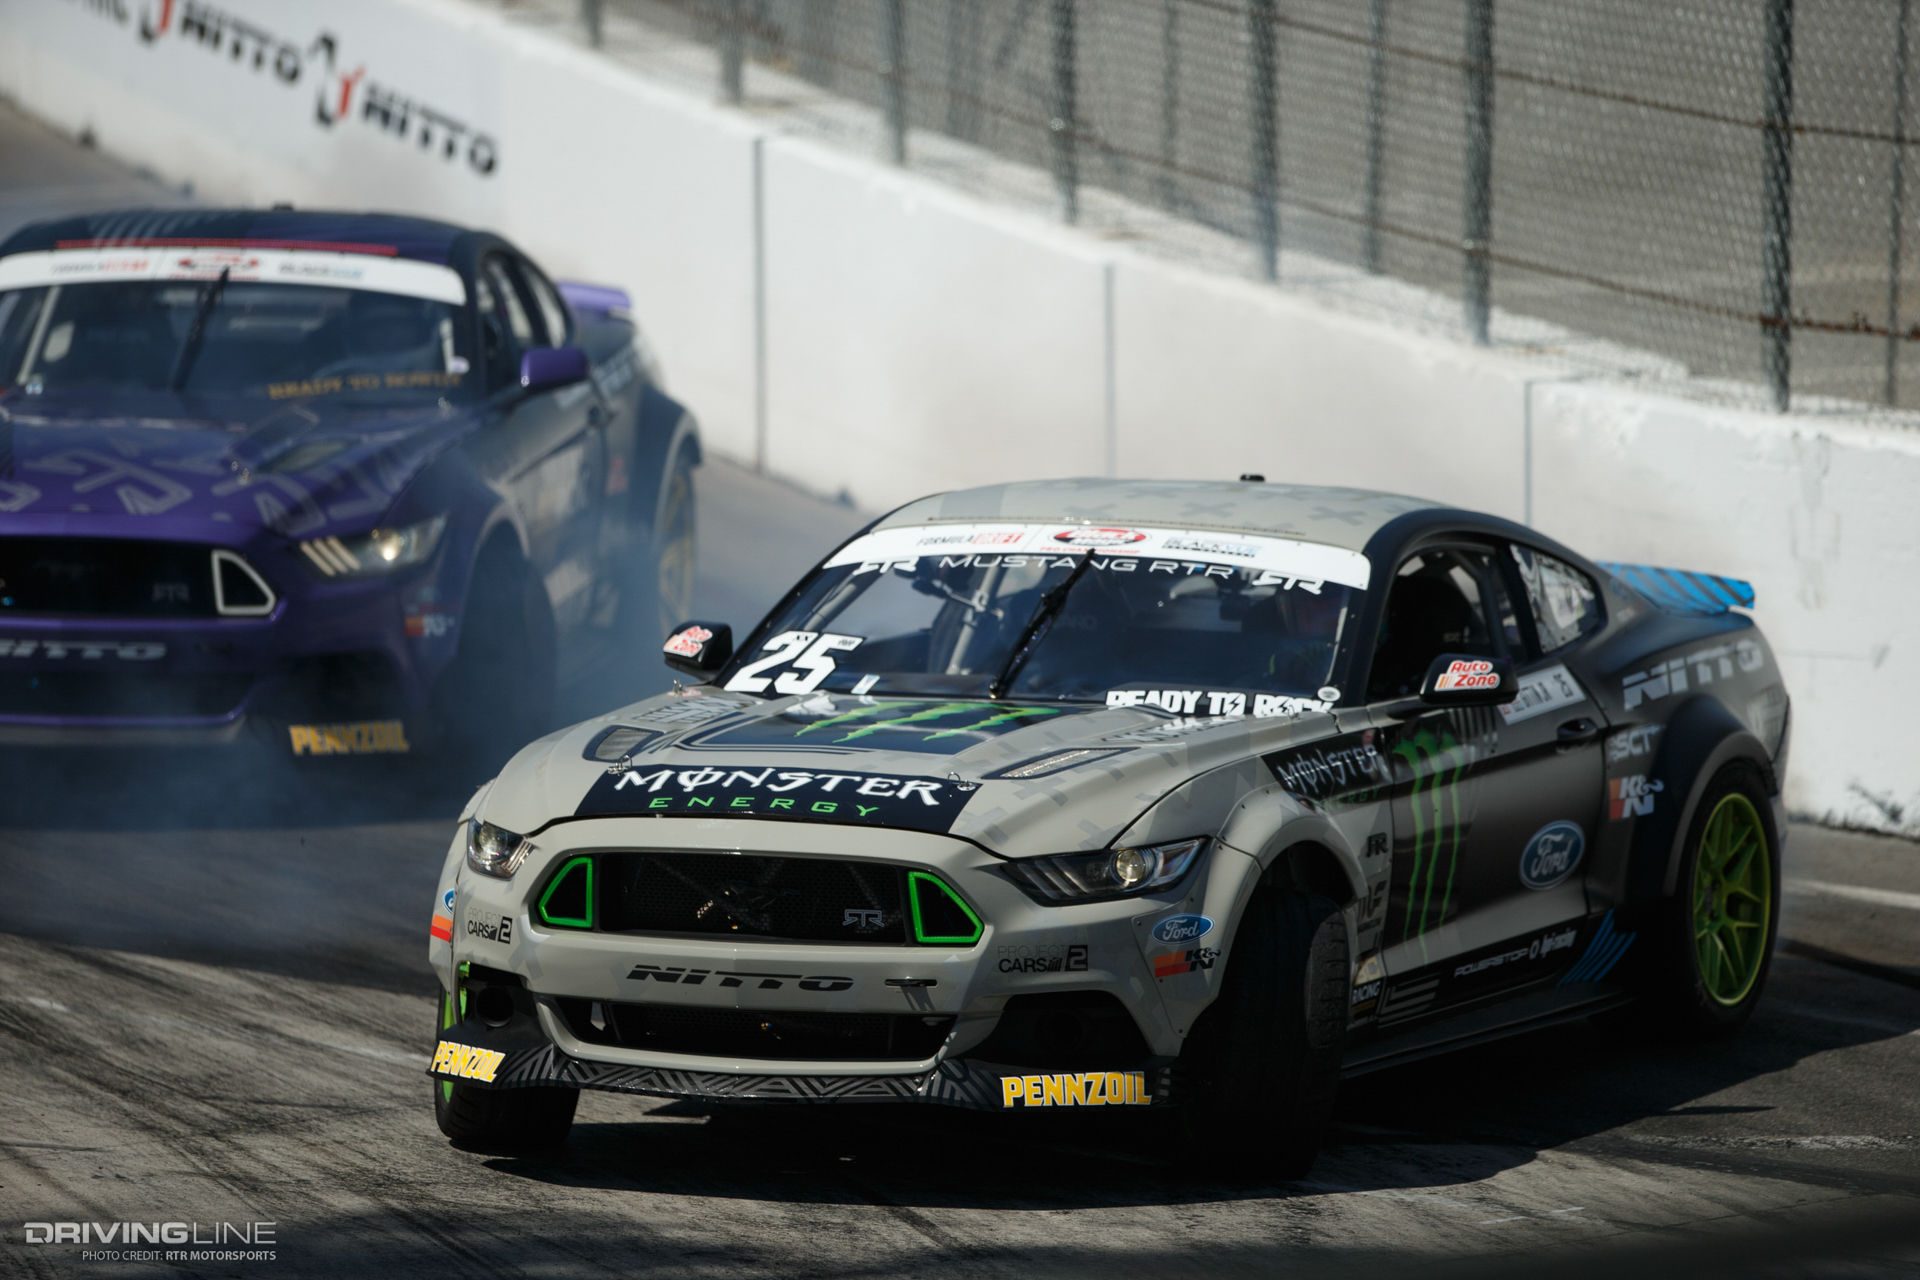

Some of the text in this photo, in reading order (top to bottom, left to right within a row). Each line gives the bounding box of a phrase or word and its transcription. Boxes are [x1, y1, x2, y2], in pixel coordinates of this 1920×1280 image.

[363, 83, 498, 176] NITTO
[1149, 560, 1234, 579] RTR
[724, 630, 867, 695] 25
[1450, 660, 1489, 673] Auto
[1623, 638, 1764, 712] NITTO
[1453, 673, 1498, 688] Zone
[1106, 690, 1203, 714] READY
[1207, 691, 1247, 716] TO
[289, 719, 411, 756] PENNZOIL
[1610, 724, 1664, 761] SCT
[1277, 744, 1389, 795] MONSTER
[613, 767, 943, 806] MONSTER
[1619, 776, 1665, 818] K&N
[648, 797, 880, 817] ENERGY
[1531, 833, 1572, 878] Ford
[468, 919, 490, 940] CARS
[1163, 918, 1200, 941] Ford
[997, 945, 1067, 959] PROJECT
[998, 958, 1048, 973] CARS
[1185, 947, 1221, 972] K&N
[626, 964, 854, 992] NITTO
[430, 1040, 506, 1083] PENNZOIL
[1000, 1071, 1152, 1108] PENNZOIL
